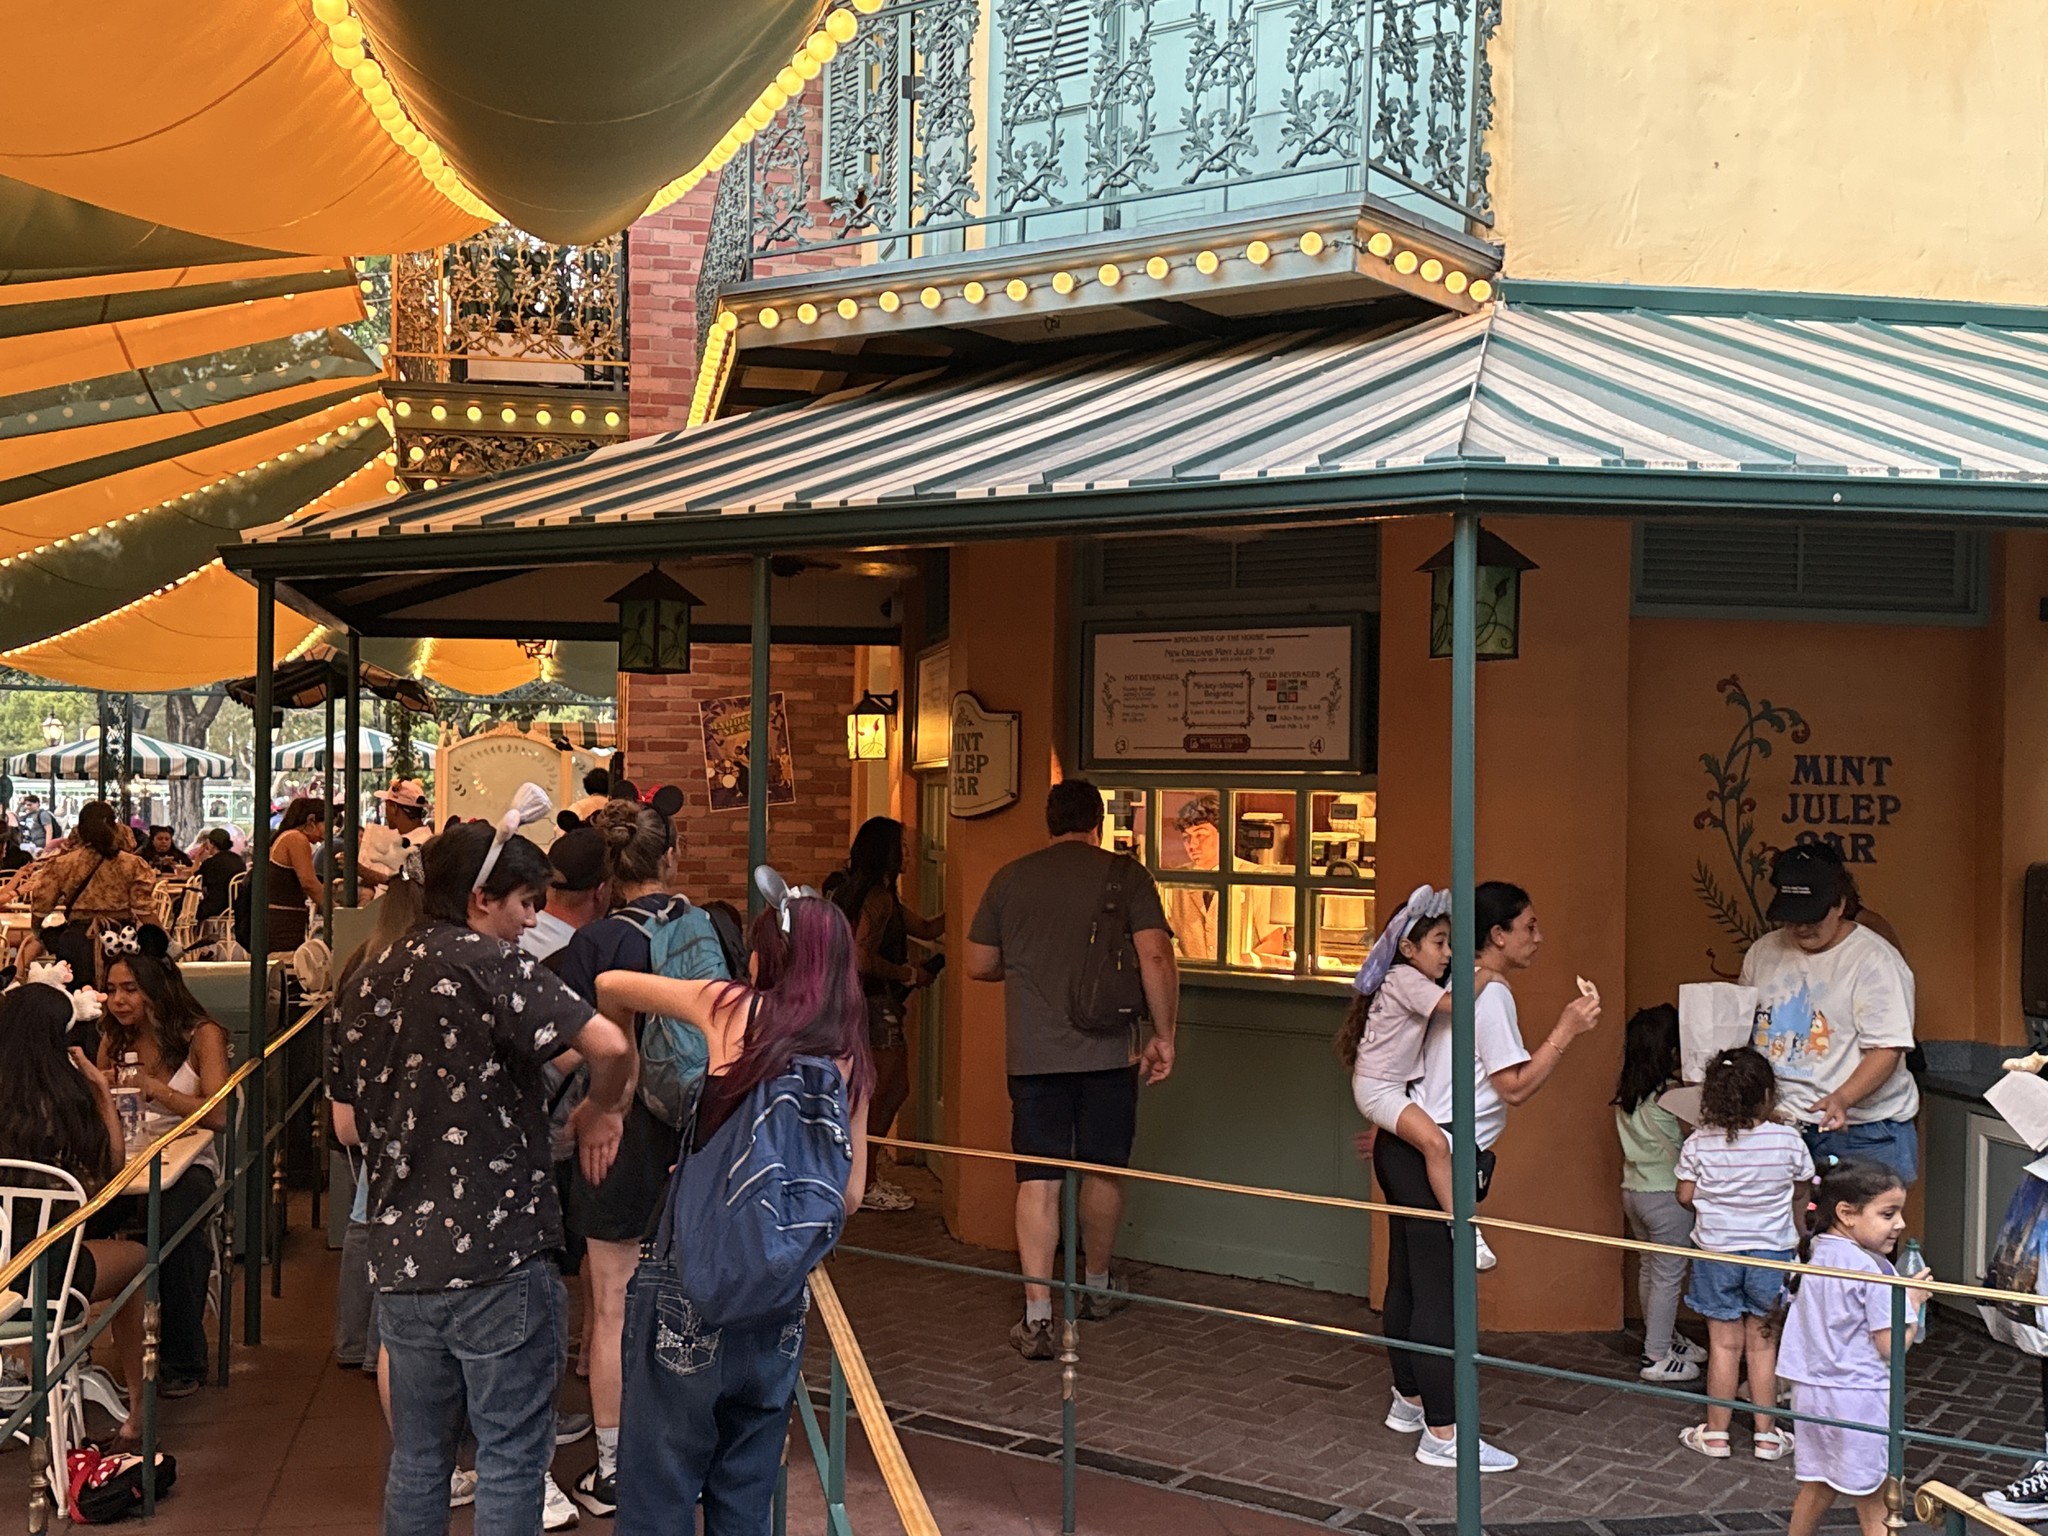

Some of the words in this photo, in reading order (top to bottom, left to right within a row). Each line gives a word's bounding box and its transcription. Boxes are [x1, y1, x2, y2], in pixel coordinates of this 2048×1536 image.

[1181, 648, 1213, 657] ORLEANS
[1124, 674, 1138, 682] HOT
[1119, 739, 1126, 751] 3
[1312, 738, 1323, 753] 4
[954, 754, 989, 774] LEP
[1790, 754, 1893, 786] MINT
[1781, 792, 1902, 825] JULEP
